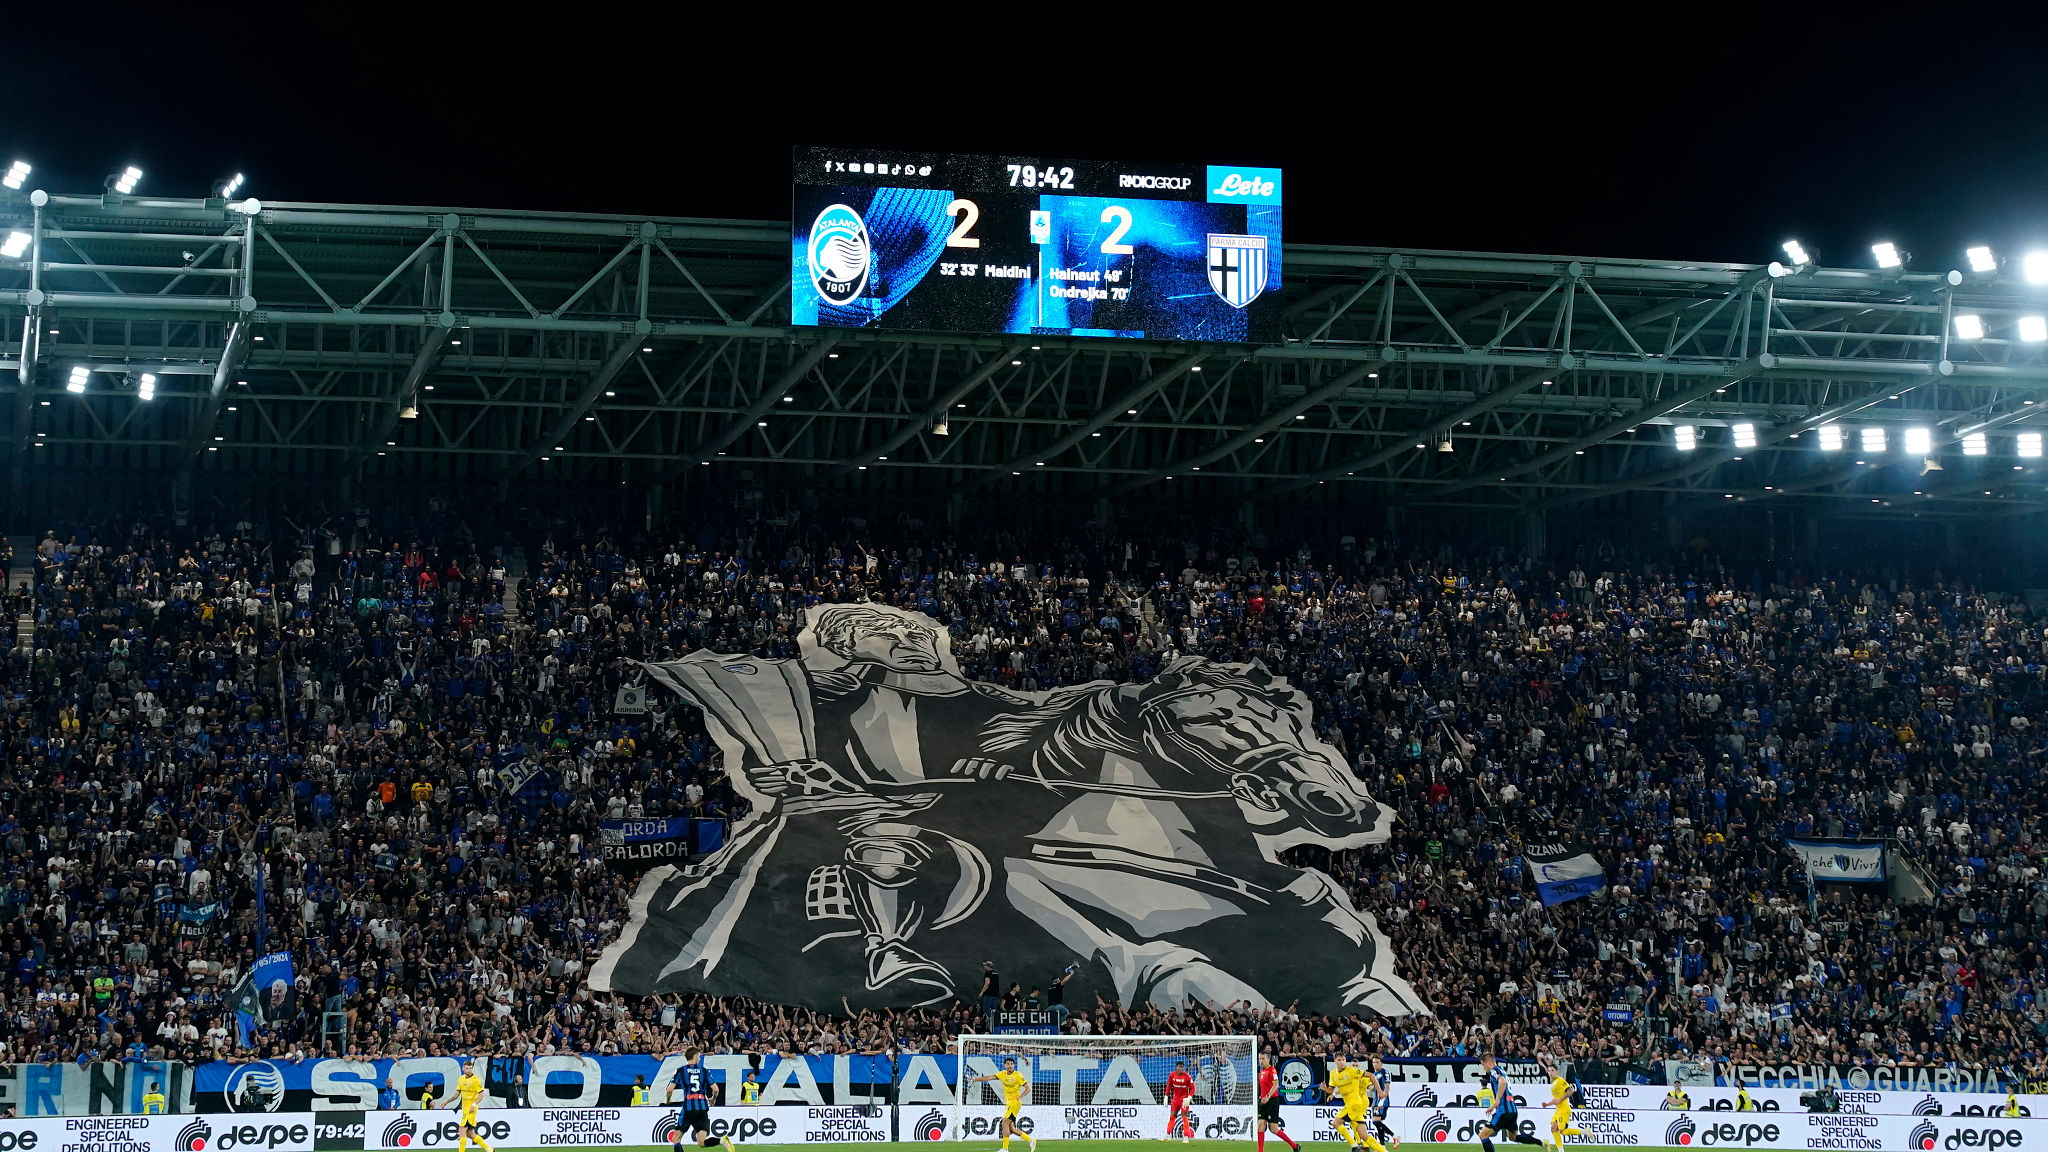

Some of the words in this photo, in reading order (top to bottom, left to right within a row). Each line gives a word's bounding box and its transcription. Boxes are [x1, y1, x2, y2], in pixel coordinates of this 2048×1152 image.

[1006, 164, 1075, 190] 79:42
[1213, 173, 1275, 197] Lete
[819, 218, 861, 232] ATALANTA
[946, 198, 980, 249] 2
[1100, 205, 1134, 255] 2
[1211, 238, 1236, 246] PARMA
[1238, 239, 1263, 248] CALCIO
[984, 264, 1032, 279] Maldini
[1049, 267, 1100, 281] Hainaut
[825, 281, 852, 294] 1907
[1049, 285, 1107, 302] Ondrejka
[622, 820, 668, 837] ORDA
[603, 841, 689, 860] BALORDA
[1000, 1012, 1025, 1024] PER
[1030, 1012, 1051, 1024] CHI
[311, 1056, 602, 1109] SOLO
[649, 1054, 1158, 1107] ATALANTA
[690, 1075, 700, 1092] 5
[1717, 1062, 1843, 1091] VECCHIA
[1873, 1065, 2001, 1094] GUARDIA
[1583, 1086, 1630, 1098] NEERED
[1585, 1098, 1618, 1109] ECIAL
[543, 1110, 621, 1121] ENGINEERED
[1064, 1107, 1138, 1118] ENGINEERED
[1570, 1111, 1635, 1122] NGINEERED
[66, 1118, 149, 1131] ENGINEERED
[556, 1121, 607, 1133] SPECIAL
[821, 1119, 870, 1130] SPECIAL
[1077, 1119, 1126, 1130] SPECIAL
[1808, 1115, 1879, 1127] ENGINEERED
[80, 1130, 134, 1142] SPECIAL
[315, 1124, 365, 1139] 79:42
[422, 1120, 511, 1146] depe
[691, 1117, 777, 1142] espe
[806, 1130, 886, 1142] DEMOLITIONS
[1062, 1129, 1141, 1140] DEMOLITIONS
[1701, 1123, 1780, 1146] despe
[1821, 1126, 1867, 1138] SPECIAL
[217, 1123, 309, 1150] despe
[540, 1132, 623, 1145] DEMOLITIONS
[1945, 1128, 2023, 1152] despe
[62, 1141, 151, 1152] DEMOLITIONS
[1807, 1138, 1882, 1149] DEMOLITIONS
